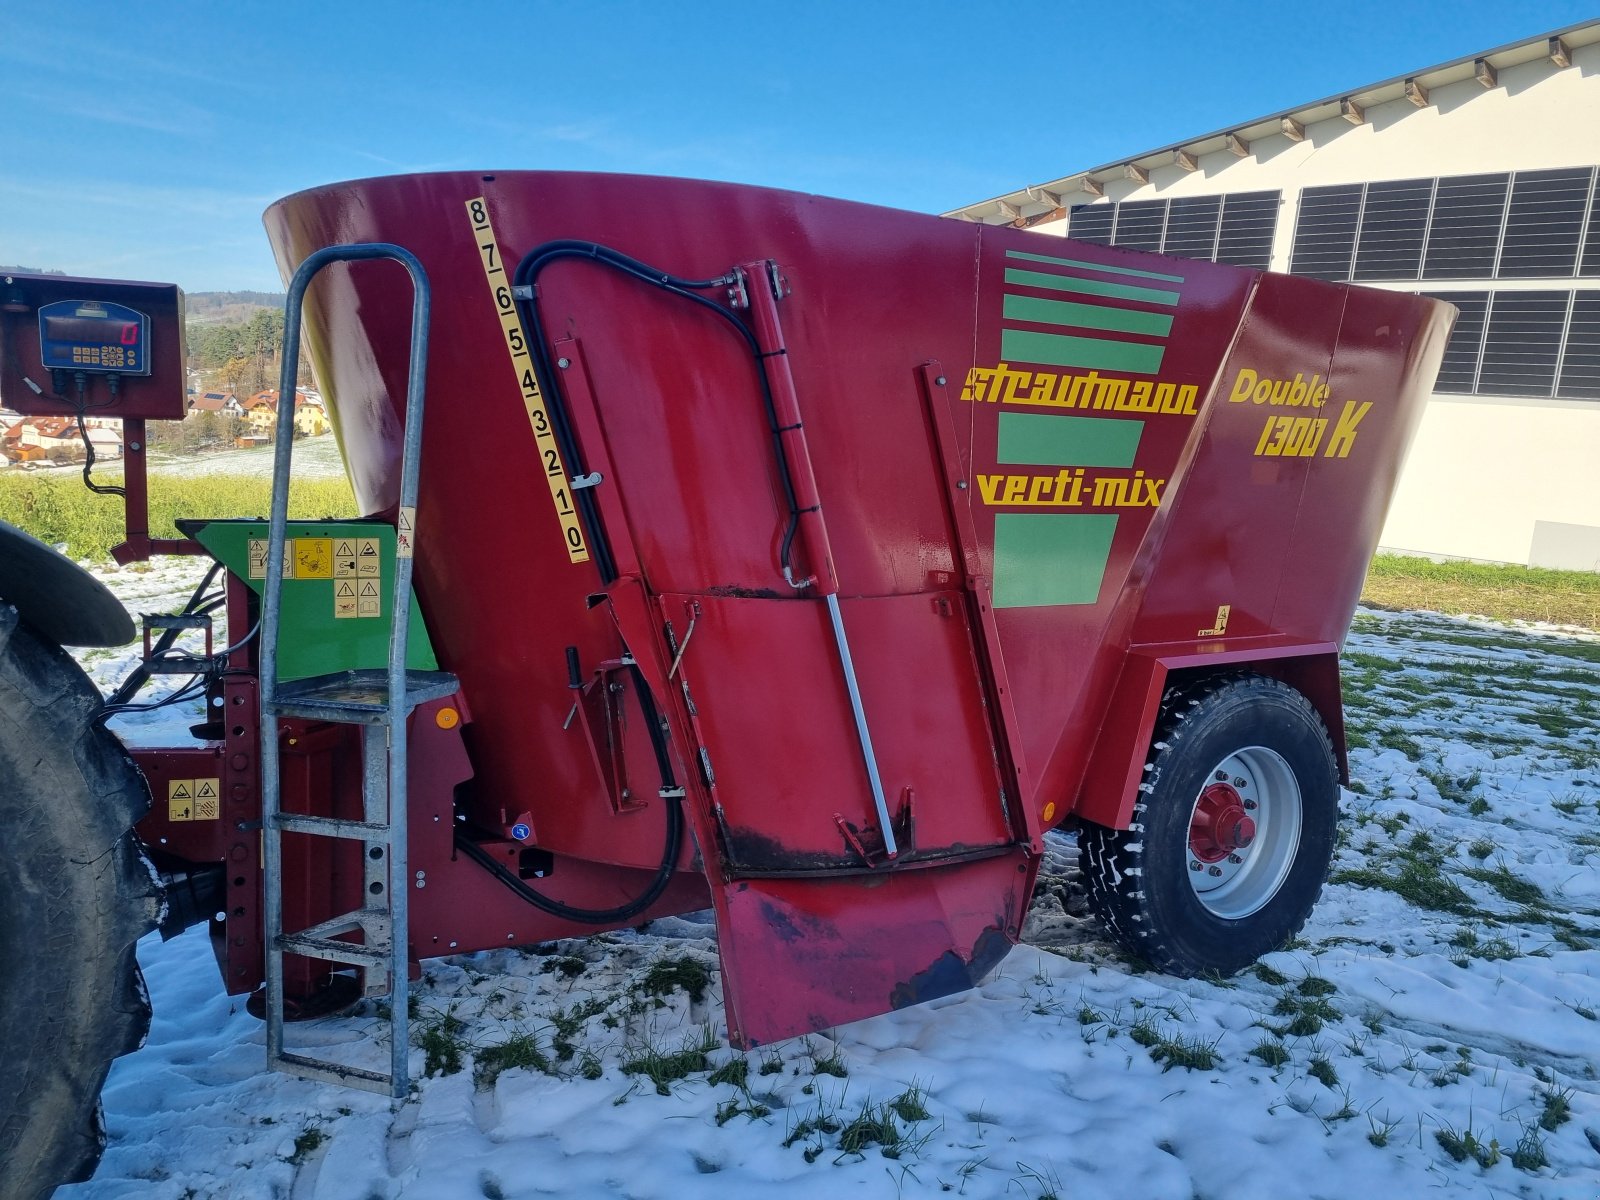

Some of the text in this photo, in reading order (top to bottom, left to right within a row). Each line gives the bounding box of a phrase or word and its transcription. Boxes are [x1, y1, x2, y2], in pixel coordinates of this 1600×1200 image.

[470, 200, 486, 224] 8
[481, 243, 496, 267] 7
[495, 286, 512, 309] 6
[121, 324, 137, 345] 0
[508, 328, 524, 351] 5
[522, 369, 536, 391] 4
[960, 364, 1198, 415] strautmann
[1229, 369, 1330, 408] Double
[532, 410, 548, 432] 3
[1254, 401, 1373, 458] 1300 K
[544, 450, 560, 472] 2
[555, 488, 569, 509] 1
[977, 469, 1165, 507] verti-mix
[567, 527, 581, 549] 0
